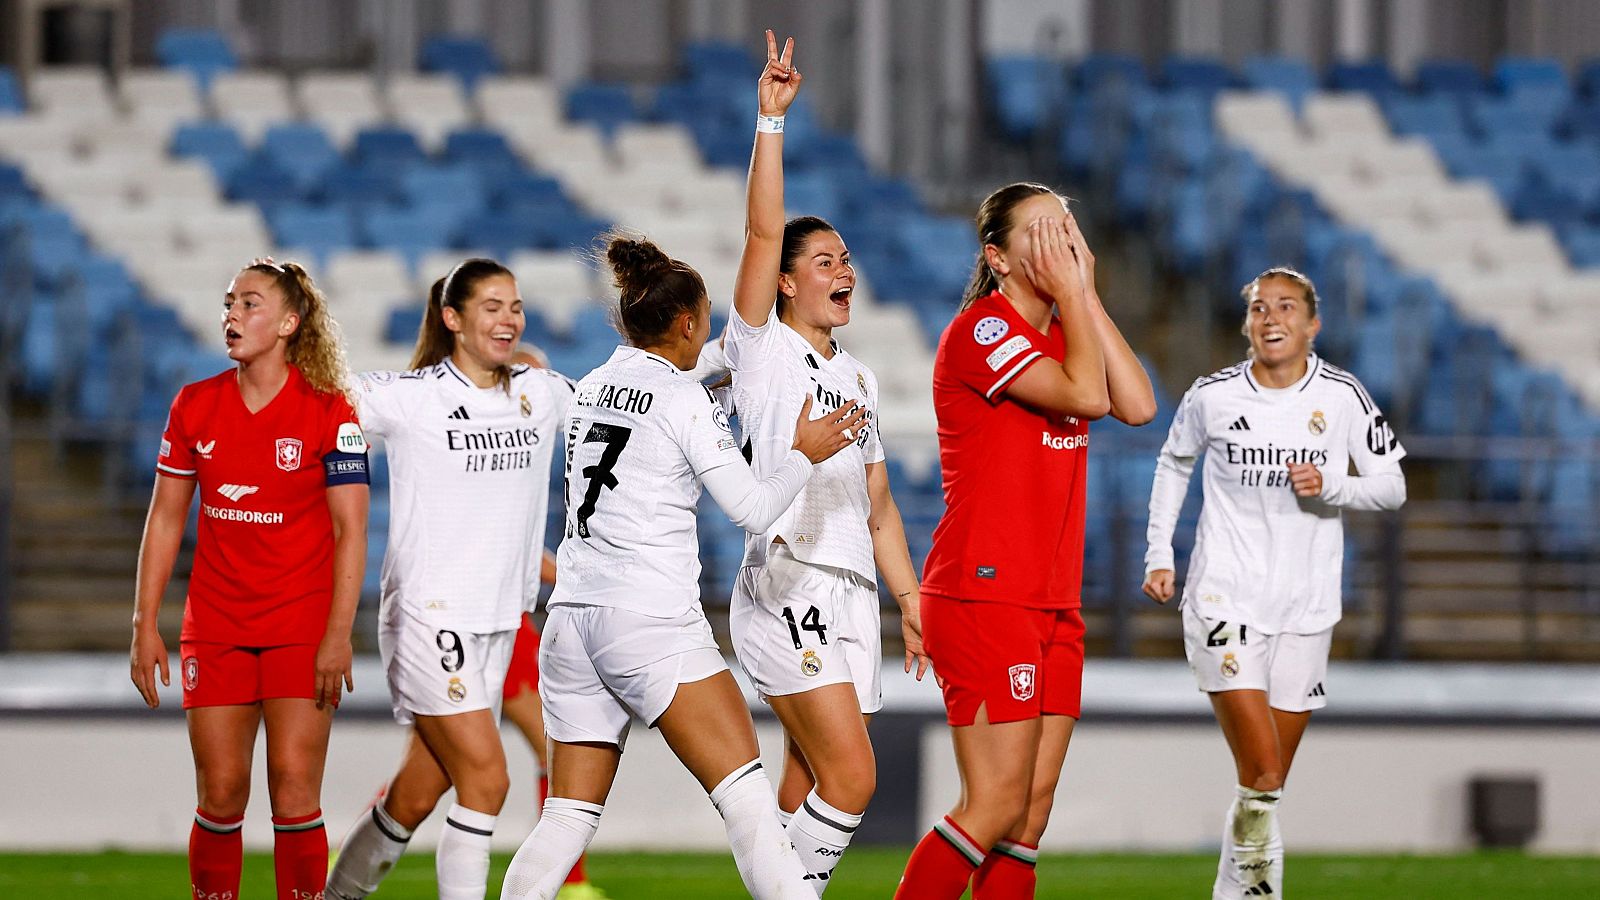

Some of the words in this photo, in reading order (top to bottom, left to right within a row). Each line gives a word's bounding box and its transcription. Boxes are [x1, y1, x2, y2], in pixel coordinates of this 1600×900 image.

[340, 434, 363, 447] TOTO
[446, 427, 540, 451] Emirates
[466, 453, 487, 473] FLY
[491, 450, 532, 471] BETTER
[1227, 443, 1328, 467] Emirates
[577, 422, 632, 539] 7
[1241, 470, 1262, 487] FLY
[781, 604, 828, 650] 14
[1205, 616, 1247, 647] 21
[436, 629, 465, 673] 9
